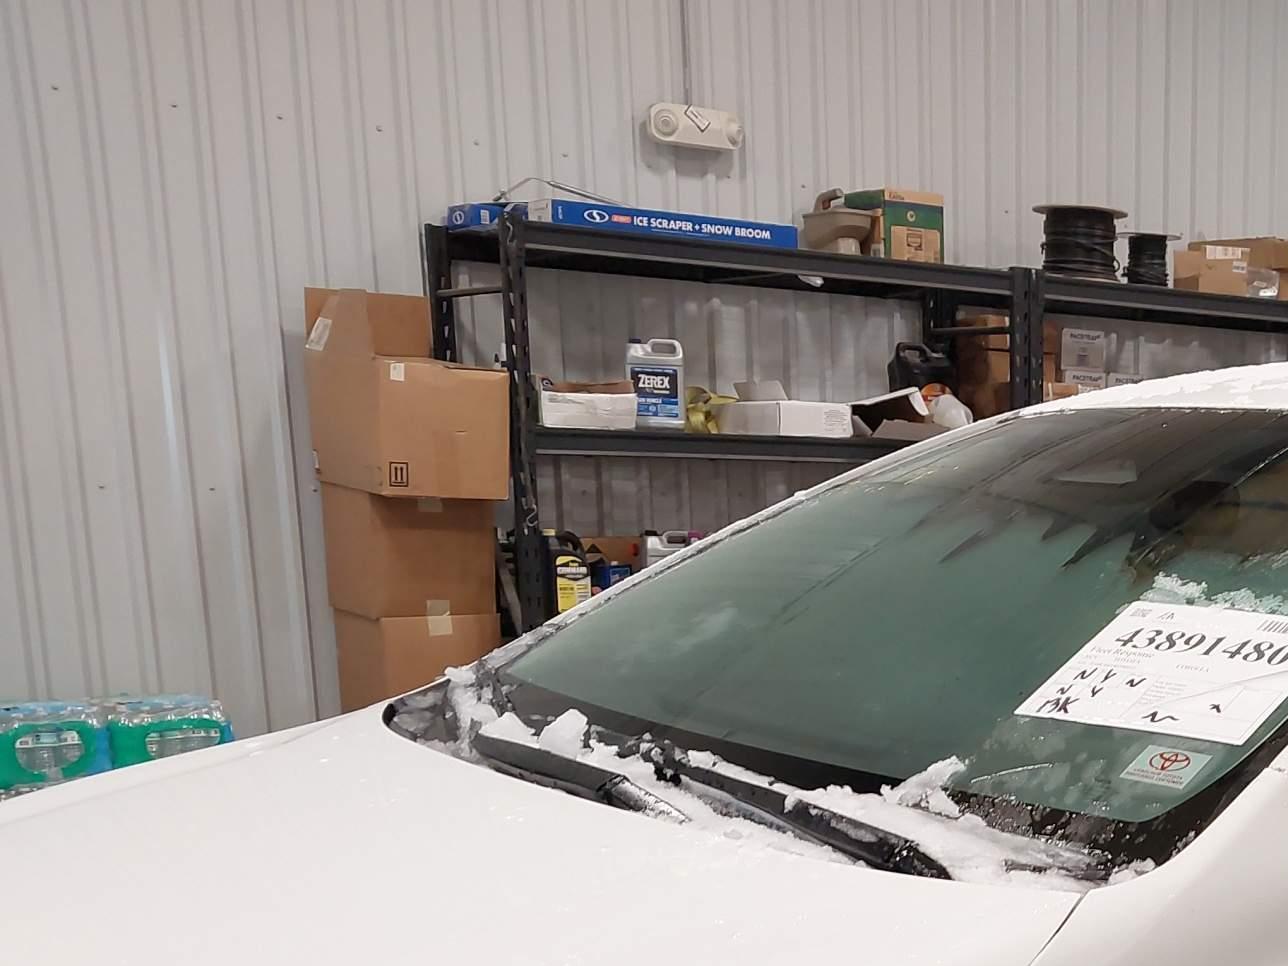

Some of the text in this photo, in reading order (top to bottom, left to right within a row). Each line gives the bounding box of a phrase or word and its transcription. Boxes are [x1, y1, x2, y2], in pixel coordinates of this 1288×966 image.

[633, 215, 649, 227] ICE
[650, 217, 694, 232] SCRAPER
[701, 223, 733, 237] SNOW
[734, 227, 772, 240] BROOM
[638, 374, 671, 389] ZEREX
